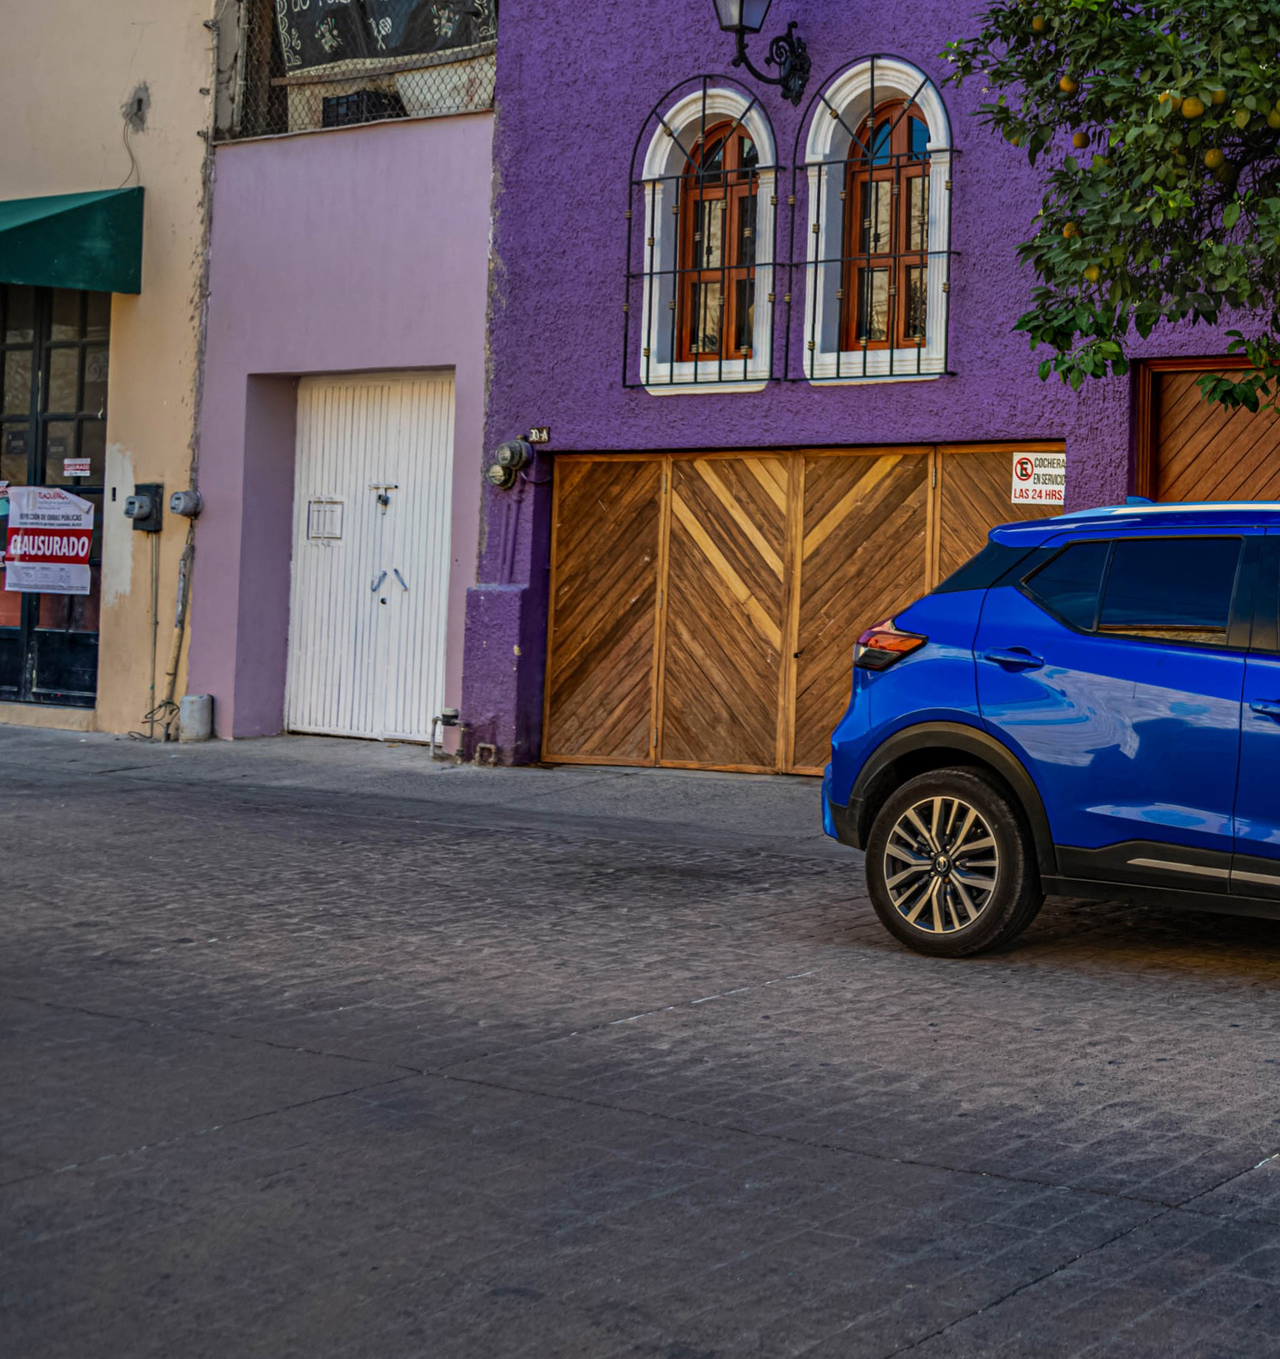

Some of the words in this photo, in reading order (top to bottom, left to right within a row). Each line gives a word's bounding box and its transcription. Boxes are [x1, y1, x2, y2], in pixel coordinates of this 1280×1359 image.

[1034, 457, 1066, 469] COCHERA
[1033, 473, 1040, 485] EN
[1013, 488, 1030, 499] LAS
[1031, 489, 1043, 500] 24
[10, 534, 89, 558] CLAUSURADO
